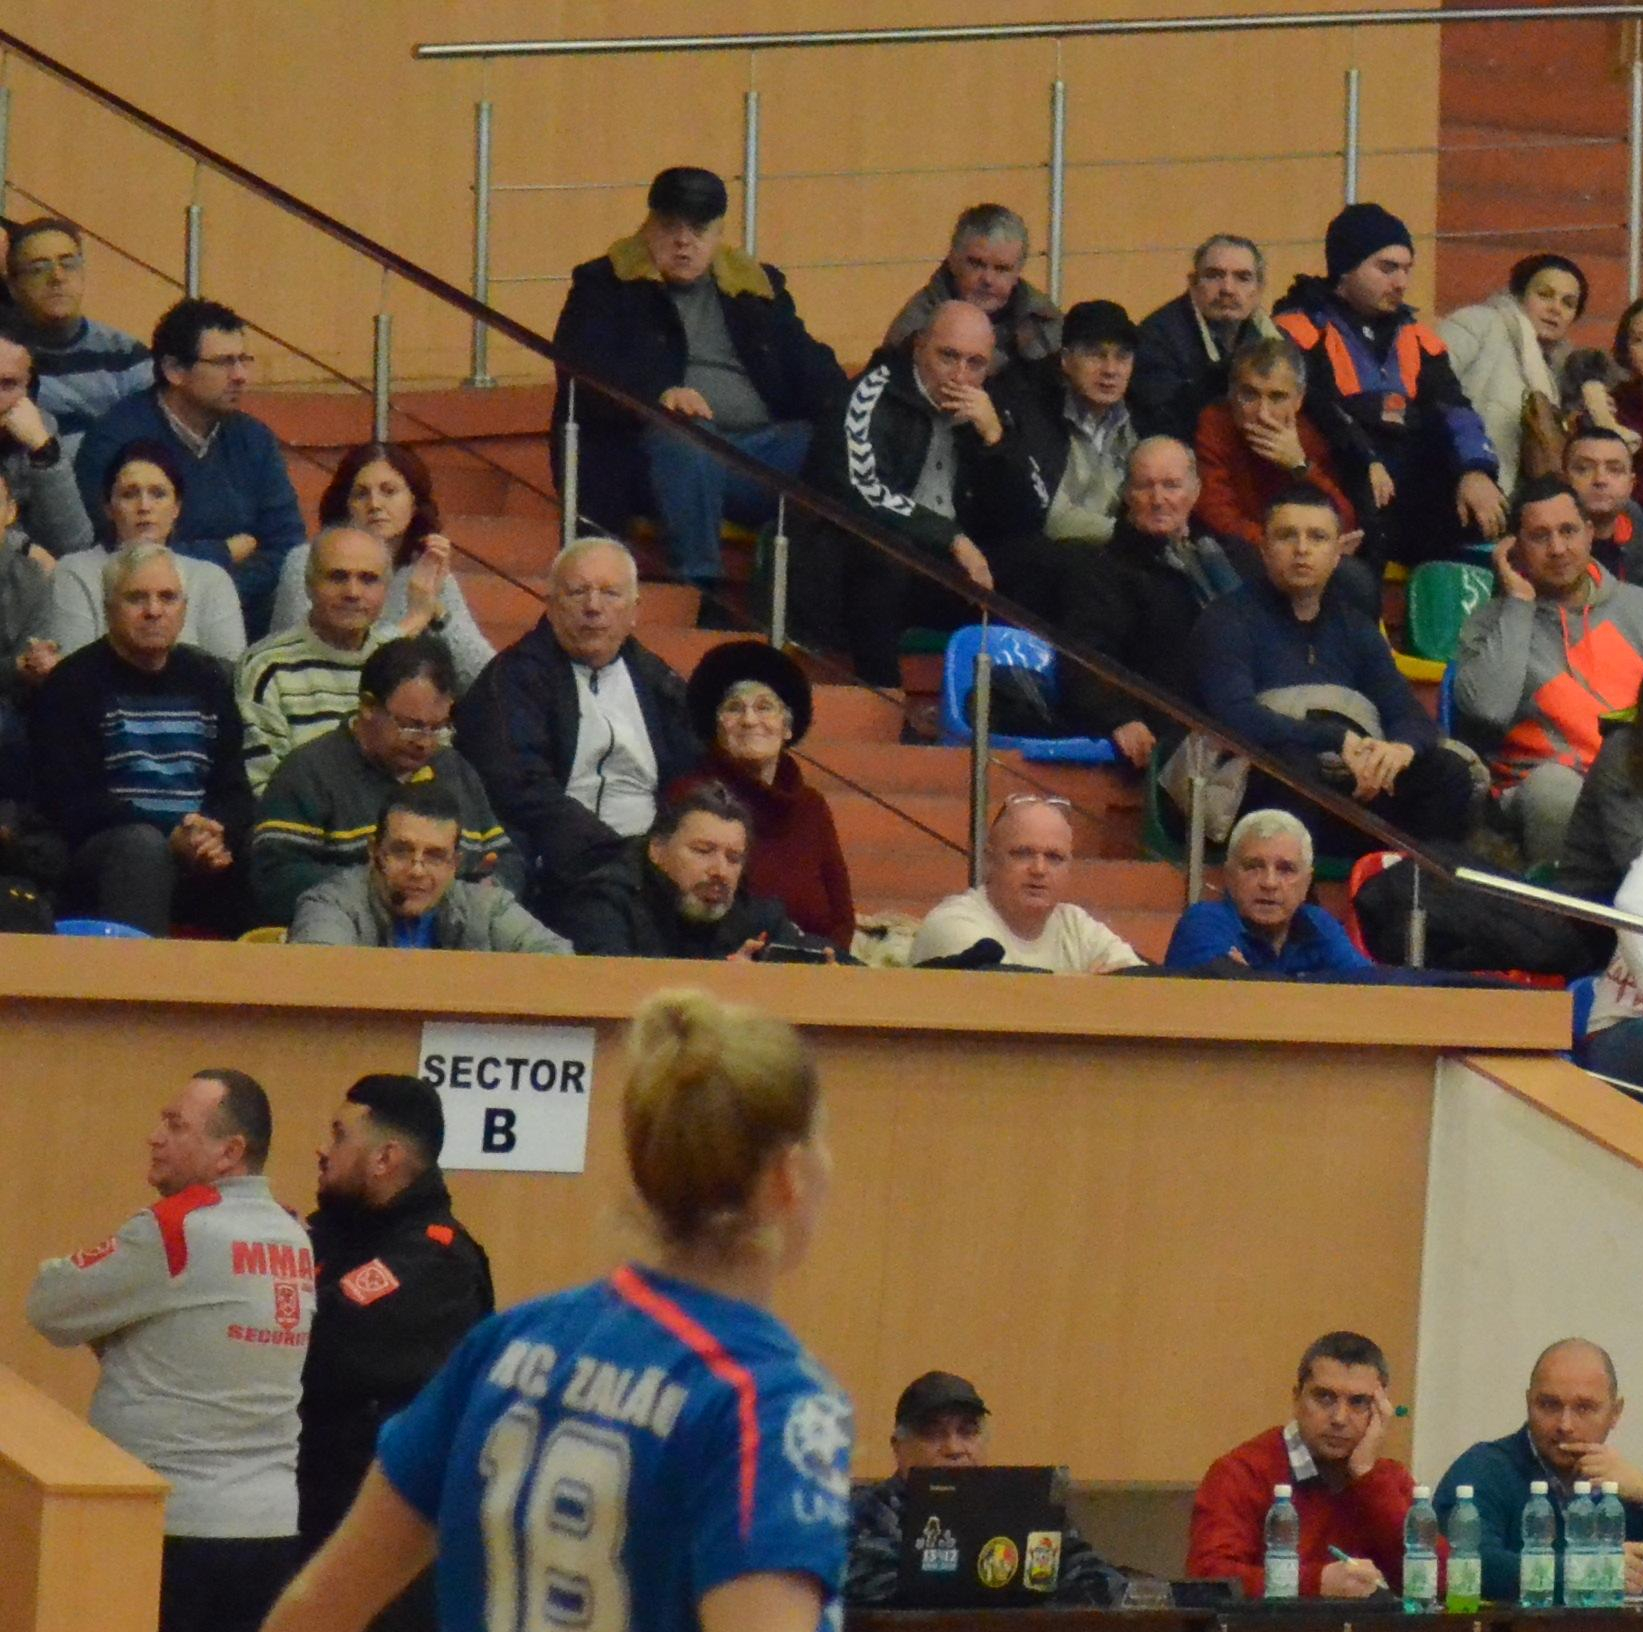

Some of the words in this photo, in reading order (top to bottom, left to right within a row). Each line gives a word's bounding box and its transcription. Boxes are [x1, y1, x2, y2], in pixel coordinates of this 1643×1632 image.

[422, 1054, 586, 1093] SECTOR
[482, 1107, 517, 1154] B
[231, 1241, 315, 1281] MMA
